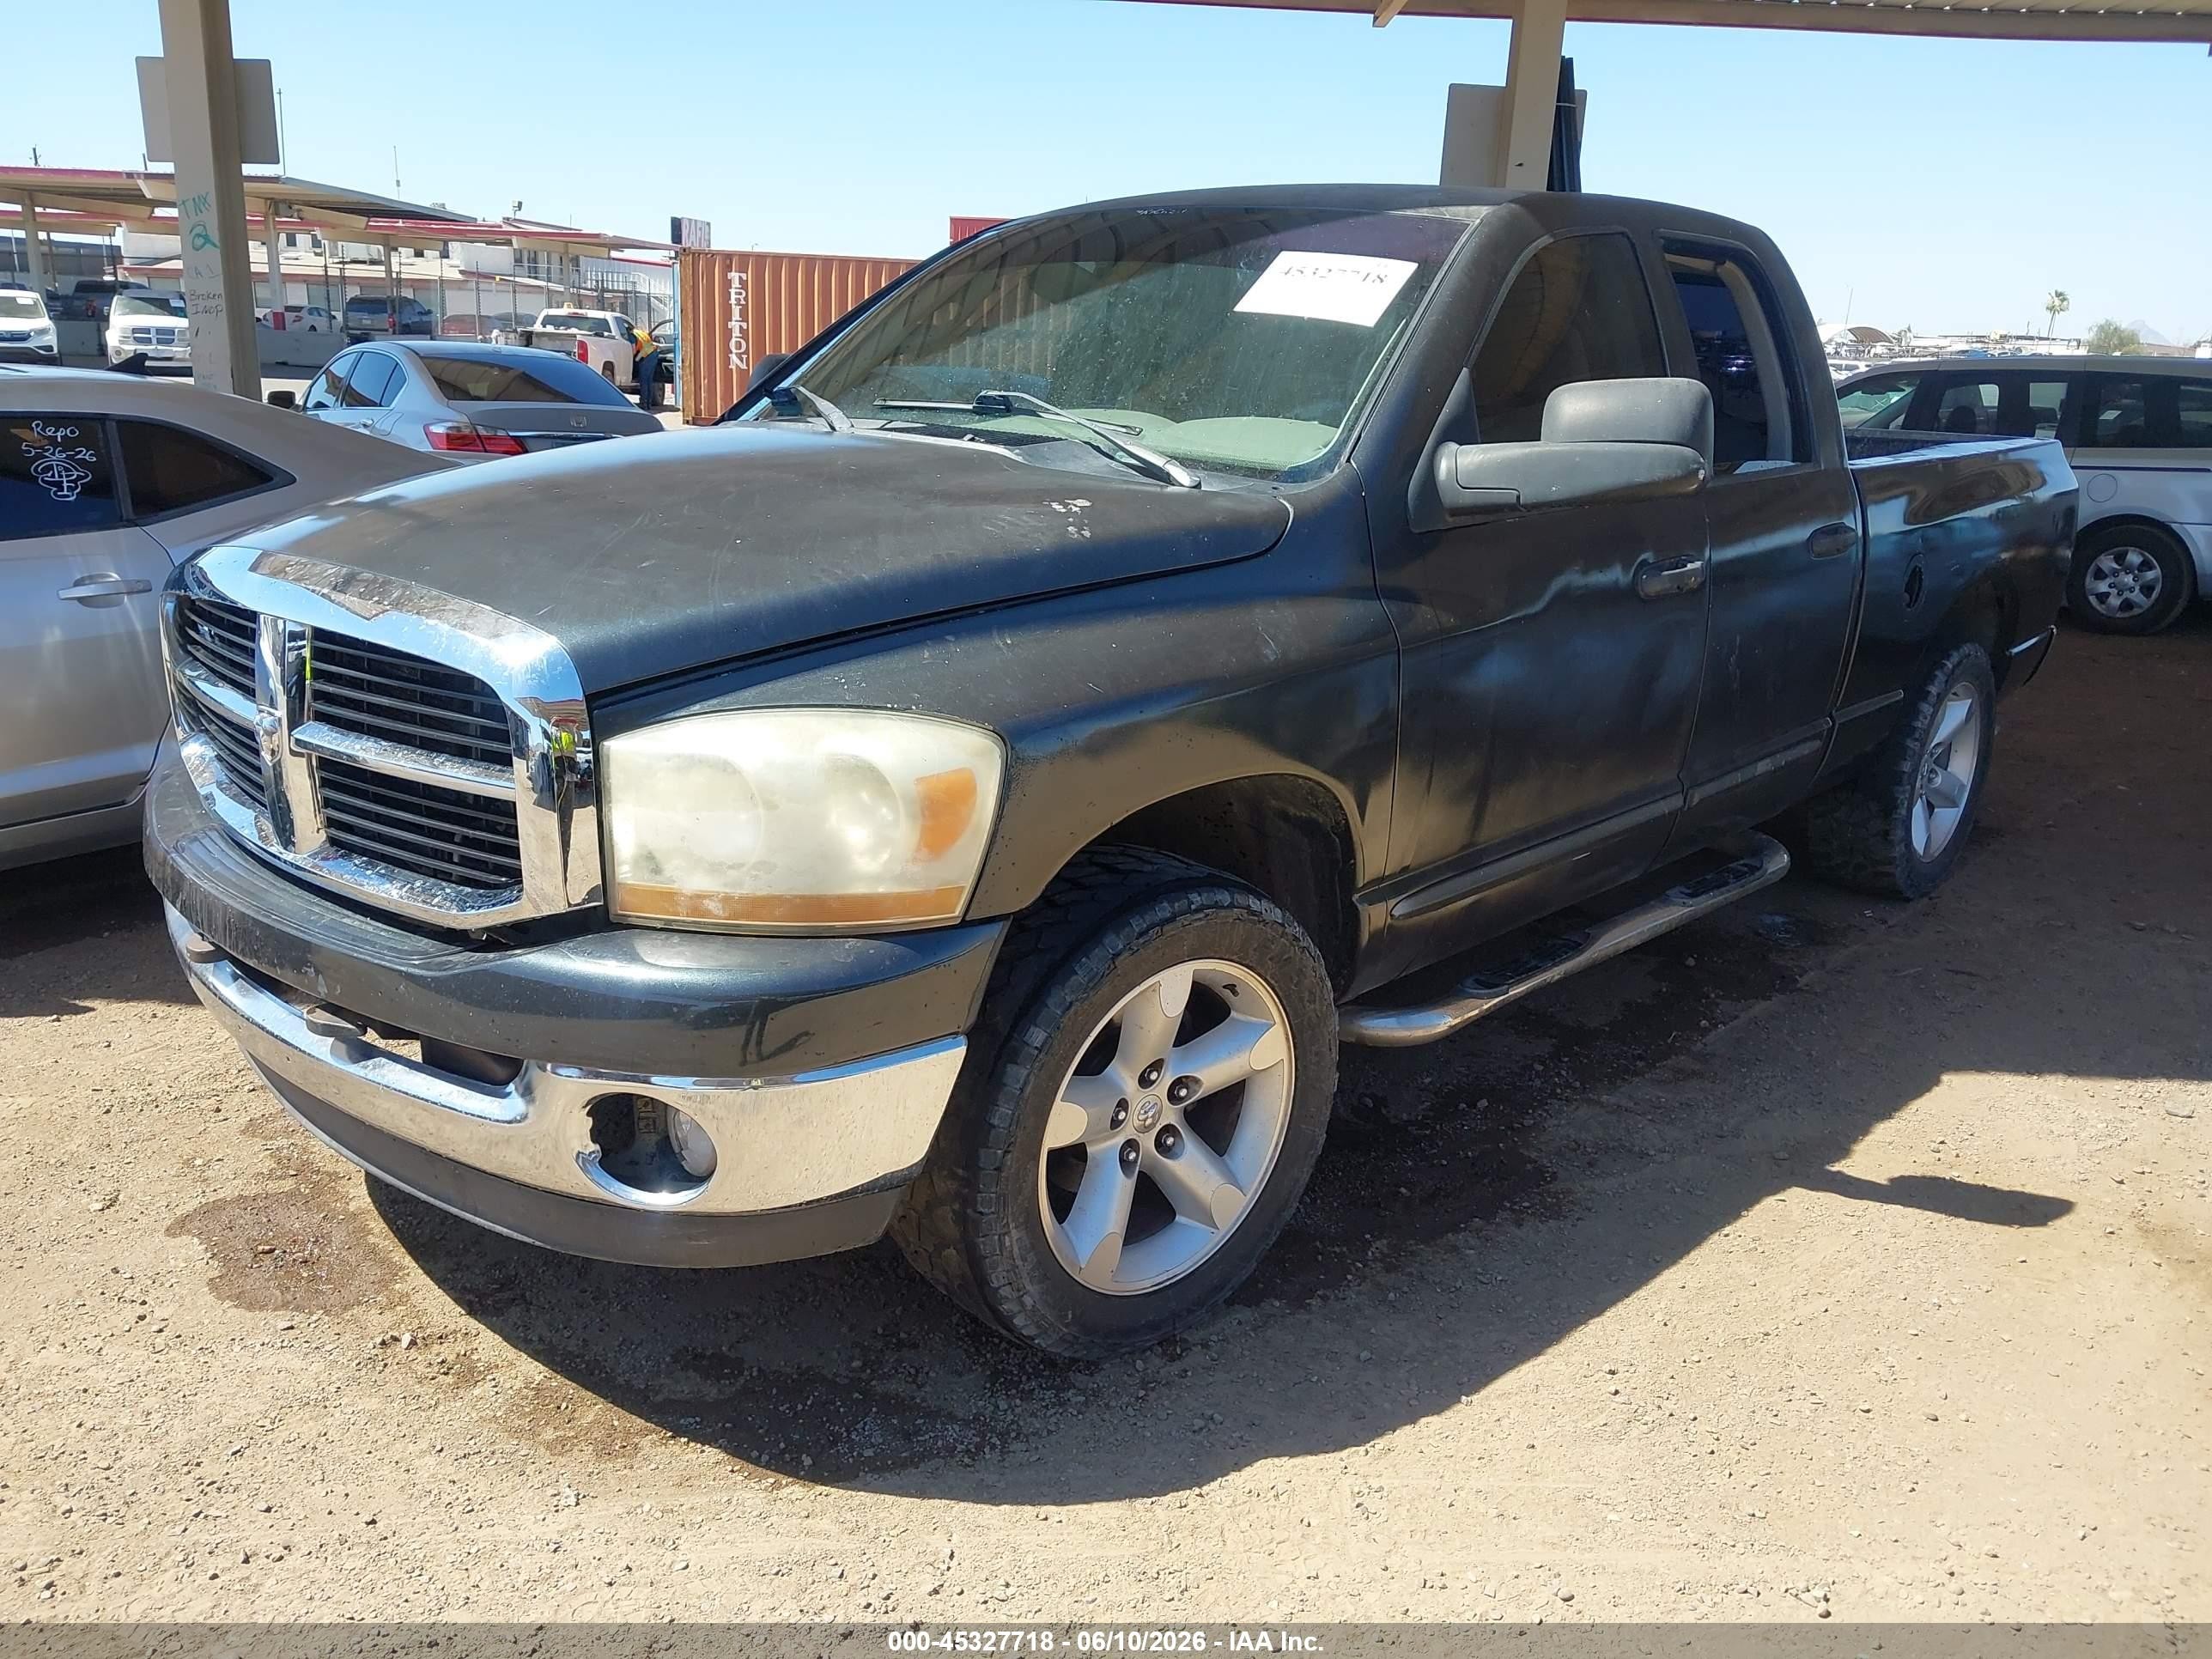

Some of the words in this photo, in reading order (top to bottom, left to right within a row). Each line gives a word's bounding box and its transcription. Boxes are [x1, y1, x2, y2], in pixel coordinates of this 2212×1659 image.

[1279, 265, 1388, 283] 453218
[727, 271, 748, 369] TRITON
[21, 442, 96, 461] 5-26-26
